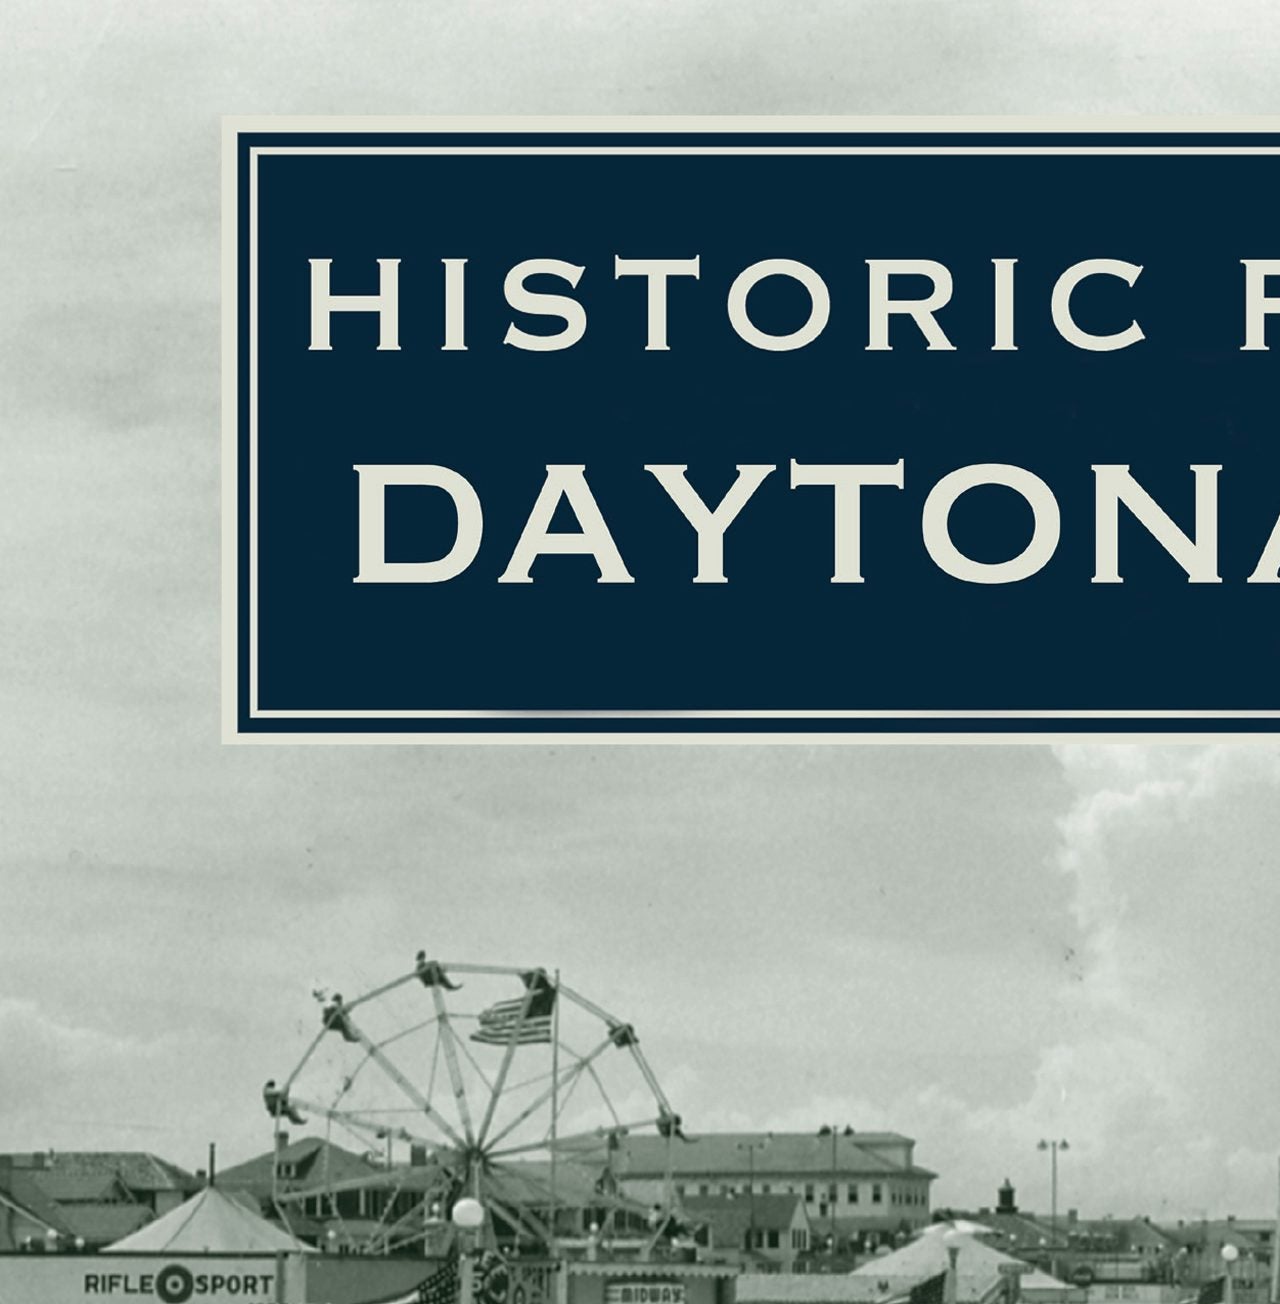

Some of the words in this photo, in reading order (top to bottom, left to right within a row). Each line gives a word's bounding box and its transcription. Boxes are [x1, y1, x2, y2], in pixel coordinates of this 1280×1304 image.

[84, 1274, 154, 1294] RIFLE
[195, 1274, 274, 1295] SPORT
[621, 1287, 682, 1303] MIDWAY
